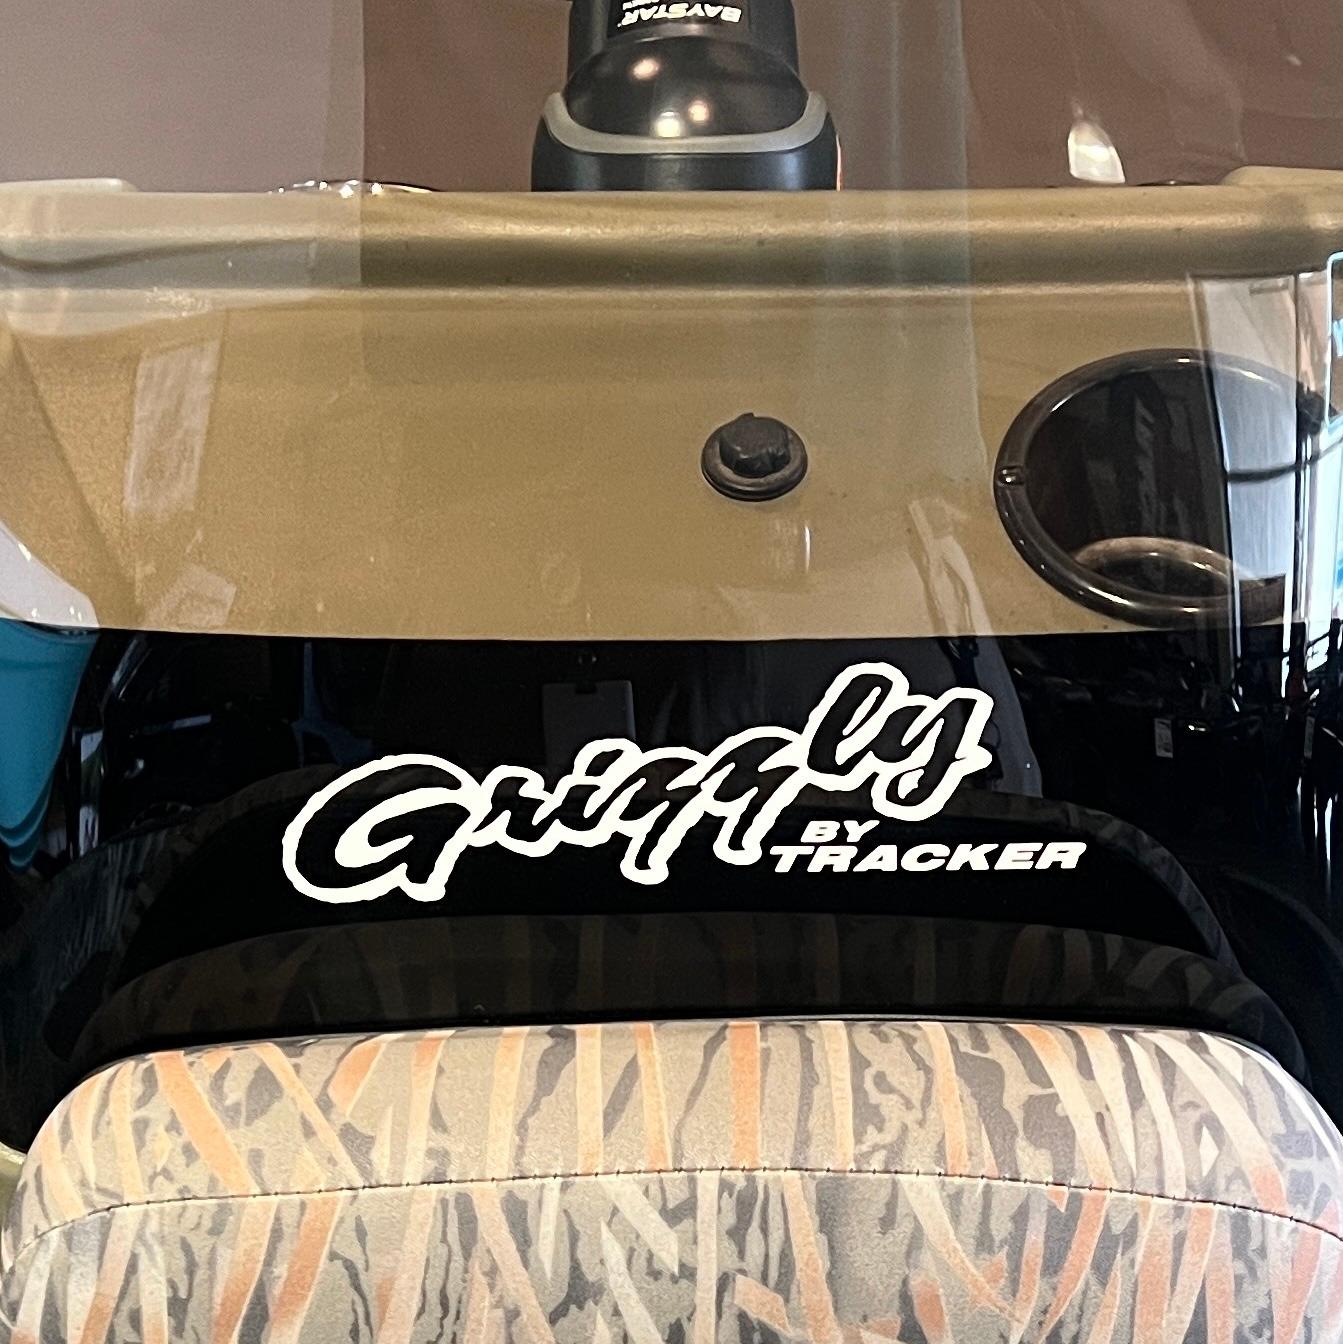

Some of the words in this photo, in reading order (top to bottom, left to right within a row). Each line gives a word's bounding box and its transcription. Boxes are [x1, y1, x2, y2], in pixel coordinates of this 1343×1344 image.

[621, 3, 742, 26] BAYSTAR
[282, 661, 994, 904] Grizzly
[801, 819, 880, 843] BY
[770, 841, 1087, 873] TRACKER
